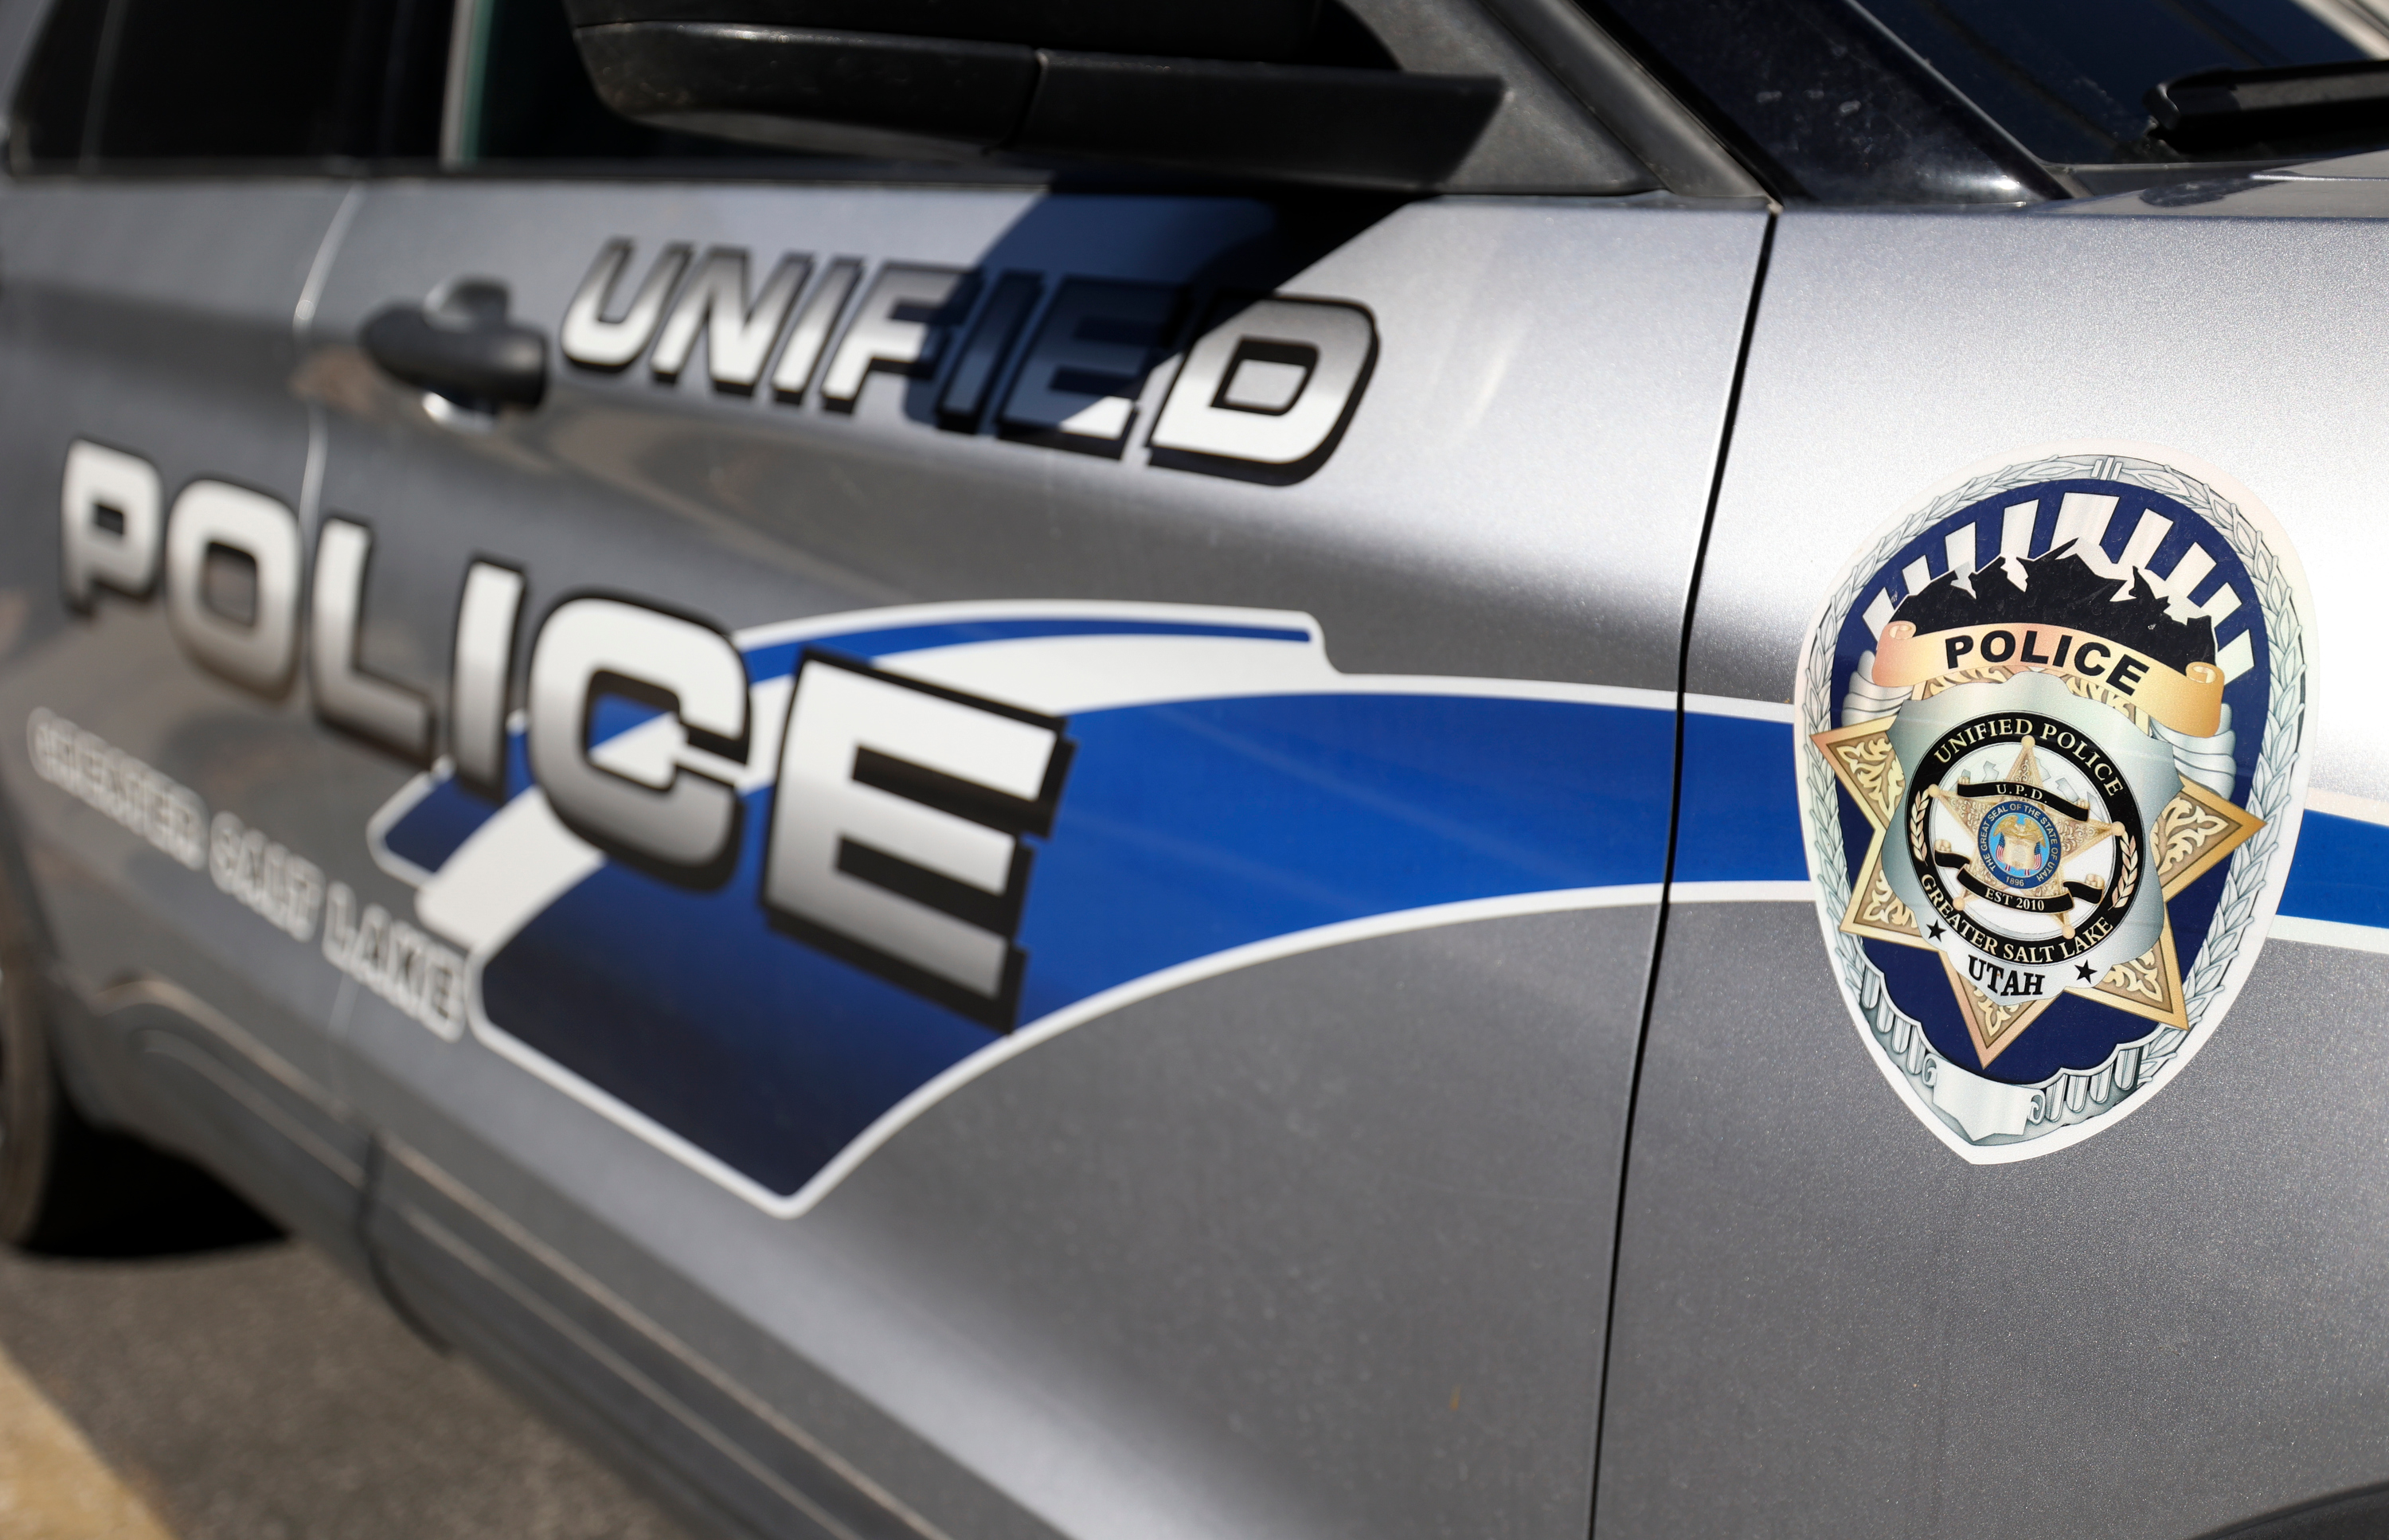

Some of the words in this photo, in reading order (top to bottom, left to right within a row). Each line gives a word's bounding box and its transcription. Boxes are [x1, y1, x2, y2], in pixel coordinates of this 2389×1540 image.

[558, 235, 1380, 487] UNIFIED
[1944, 629, 2150, 696] POLICE
[61, 437, 1077, 1035] POLICE
[1933, 718, 2033, 764] UNIFIED
[2040, 723, 2125, 797] POLICE
[1996, 784, 2048, 804] U.P.D.
[1988, 805, 2008, 822] SEAL
[2023, 804, 2041, 819] THE
[1980, 820, 1990, 851] GREAT
[2040, 817, 2058, 845] STATE
[1983, 853, 1997, 872] THE
[2051, 847, 2059, 861] OF
[2006, 876, 2025, 887] 1896
[2036, 862, 2055, 882] UTAH
[1984, 887, 2013, 910] EST
[2016, 897, 2045, 912] 2010
[1921, 873, 2000, 956] GREATER
[2003, 943, 2055, 964] SALT
[2059, 916, 2113, 960] LAKE
[323, 881, 467, 1044] LAKE
[1968, 954, 2046, 997] UTAH
